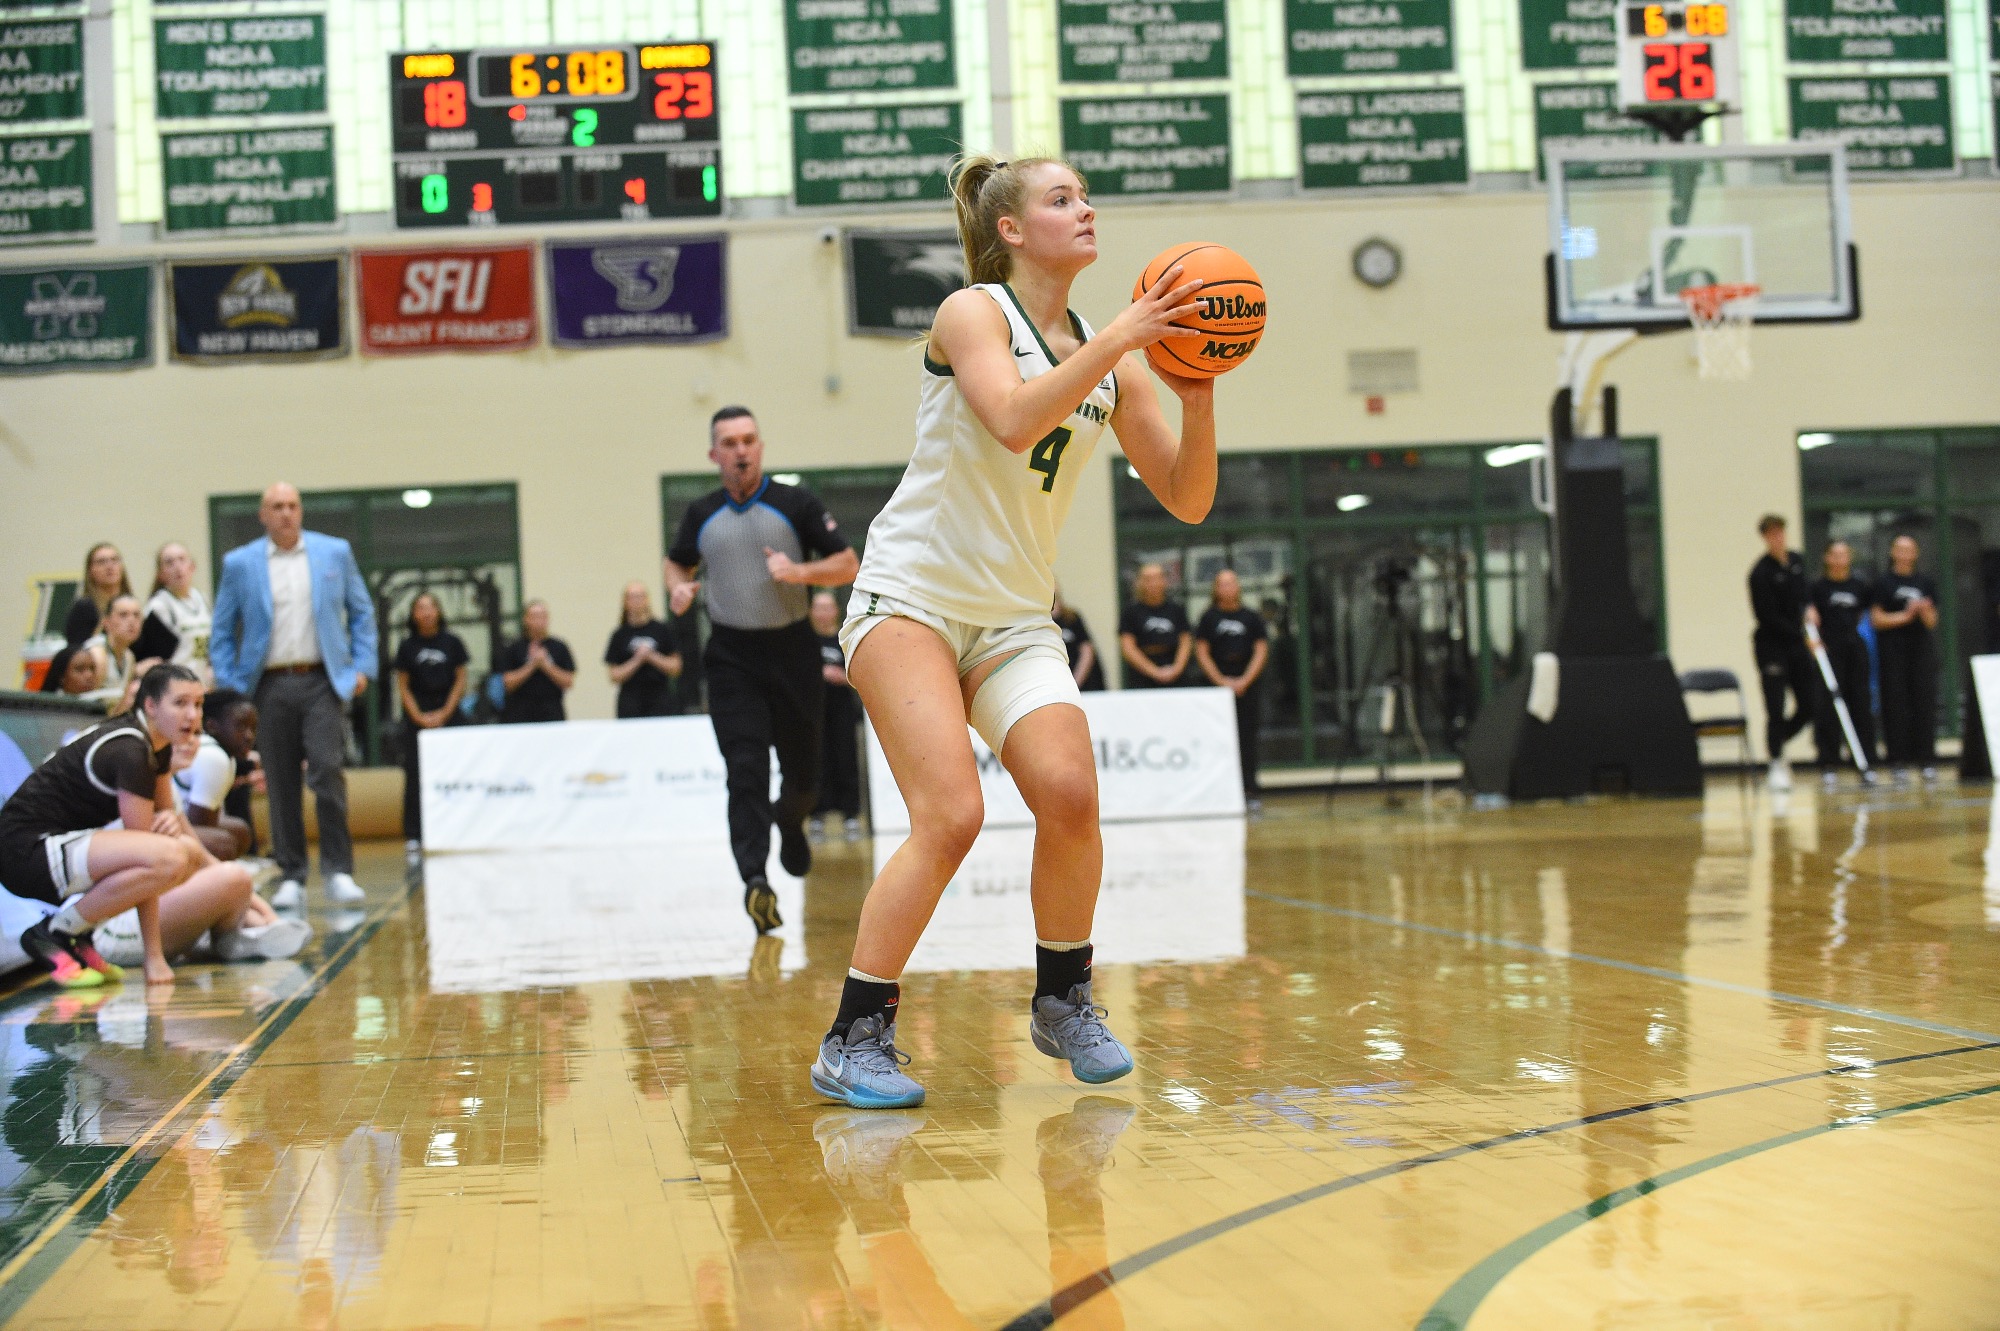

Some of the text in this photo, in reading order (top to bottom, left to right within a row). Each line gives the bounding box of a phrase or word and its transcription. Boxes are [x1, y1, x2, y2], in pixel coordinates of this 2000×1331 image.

[1107, 4, 1175, 23] NCAA
[1333, 6, 1400, 25] NCAA
[833, 20, 902, 42] NCAA
[1292, 27, 1446, 50] CHAMPIONSHIPS
[1549, 24, 1614, 43] FINAL
[1789, 16, 1944, 37] TOURNAMENT
[205, 45, 275, 66] NCAA
[794, 42, 946, 68] CHAMPIONSHIPS
[160, 67, 324, 92] TOURNAMENT
[510, 51, 626, 98] 6:08
[1643, 43, 1716, 100] 26
[424, 80, 467, 128] 18
[654, 71, 714, 120] 23
[1360, 92, 1461, 114] LACROSSE
[1078, 101, 1210, 123] BASEBALL
[1836, 104, 1903, 123] NCAA
[571, 108, 599, 147] 2
[1110, 126, 1181, 146] NCAA
[1347, 118, 1414, 137] NCAA
[842, 134, 912, 154] NCAA
[1304, 138, 1461, 164] SEMIFINALIST
[214, 157, 283, 178] NCAA
[421, 174, 449, 214] 0
[701, 164, 717, 202] 1
[472, 182, 493, 213] 3
[399, 258, 492, 316] SFU
[1195, 294, 1266, 320] Wilson
[369, 317, 530, 343] SAINT FRANCIS
[582, 312, 698, 338] STONEHILL
[198, 327, 319, 352] NEW HAVEN
[1199, 337, 1257, 359] NCAA
[1028, 424, 1075, 495] 4
